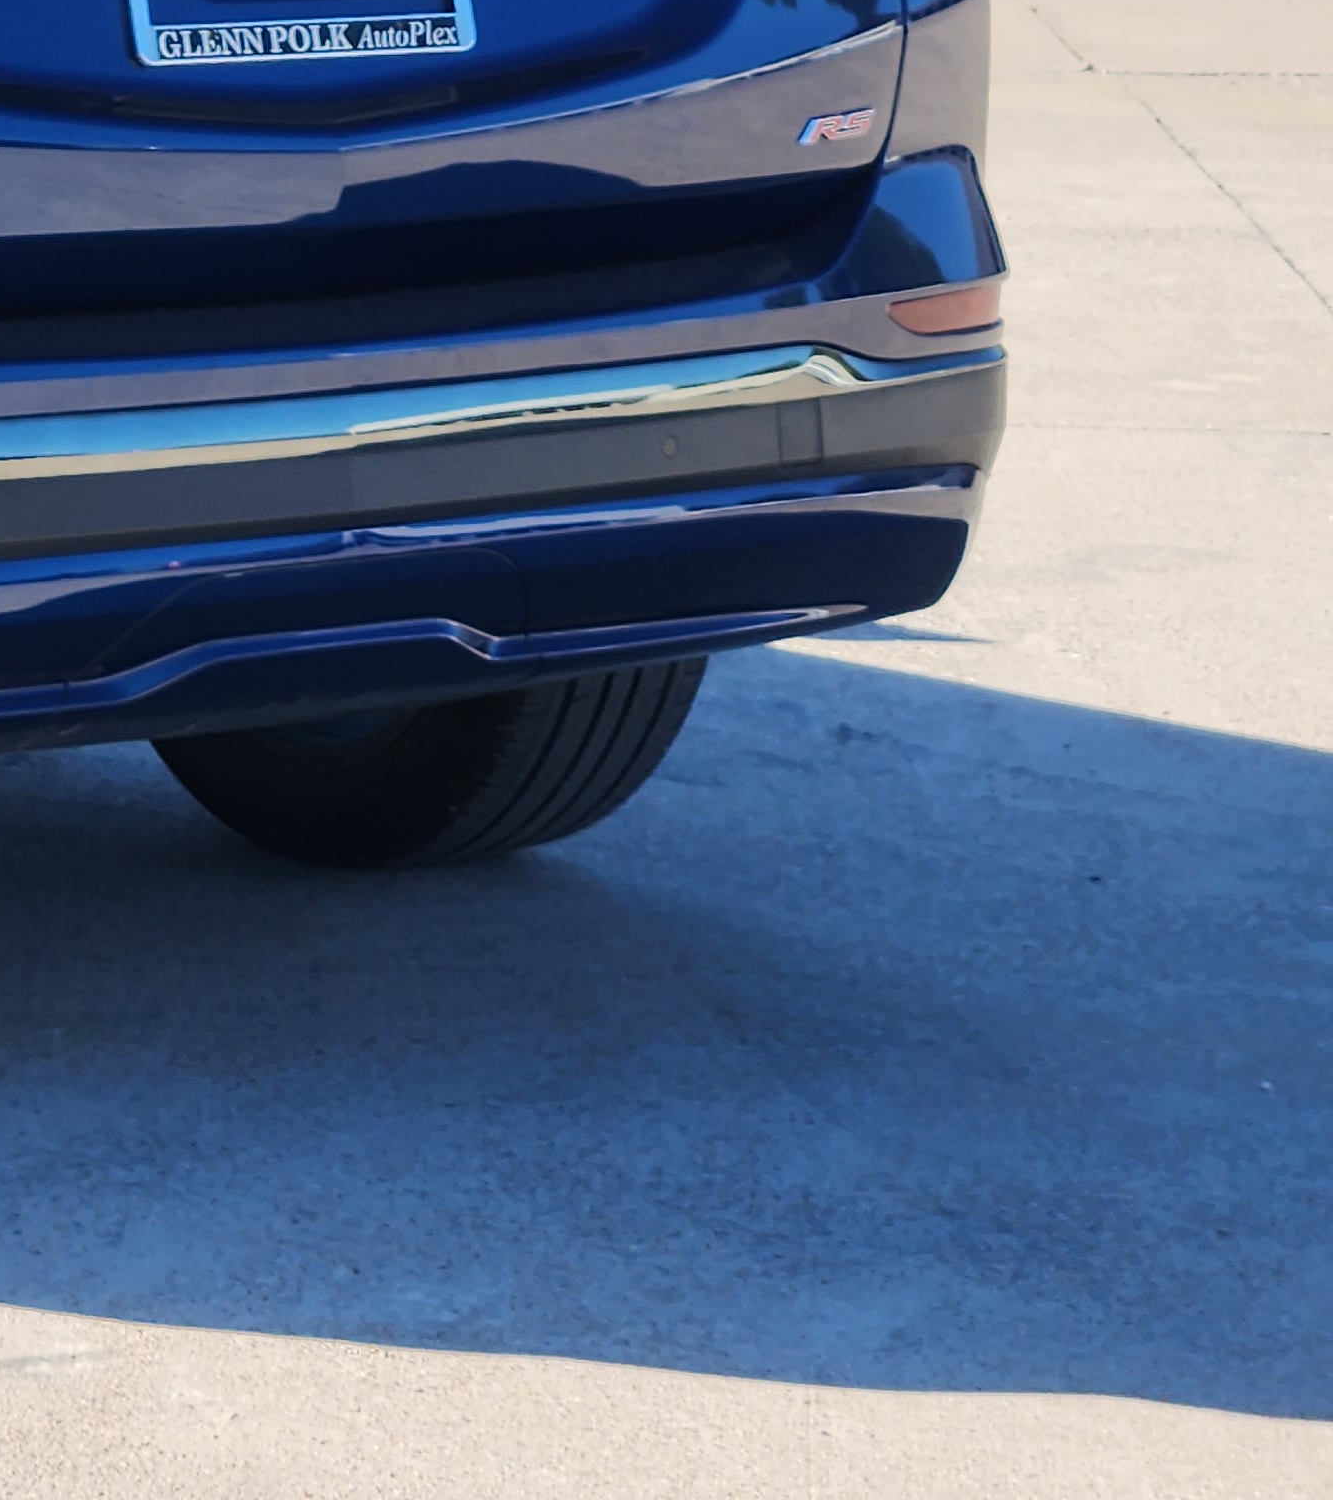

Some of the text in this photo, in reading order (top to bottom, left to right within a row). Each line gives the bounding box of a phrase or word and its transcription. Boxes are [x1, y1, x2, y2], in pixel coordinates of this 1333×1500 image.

[158, 20, 458, 60] GLENN POLK AutoPlex
[803, 108, 874, 145] RS
